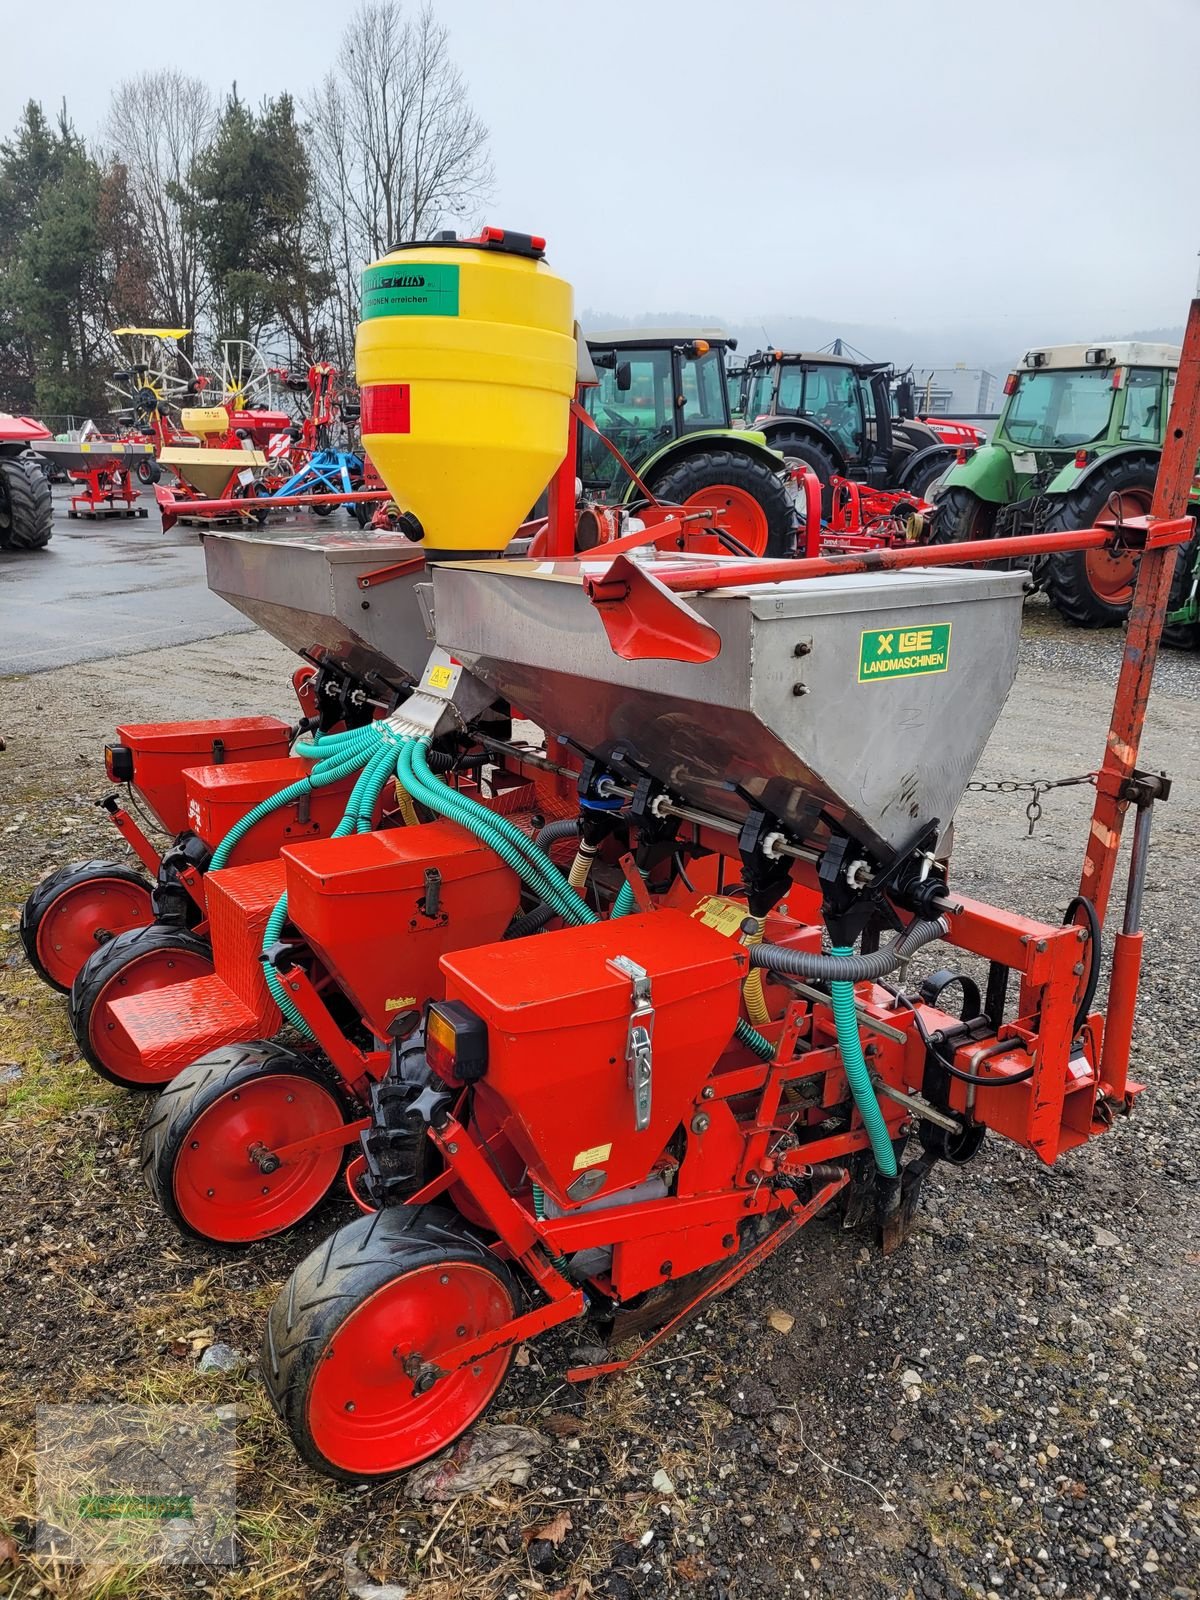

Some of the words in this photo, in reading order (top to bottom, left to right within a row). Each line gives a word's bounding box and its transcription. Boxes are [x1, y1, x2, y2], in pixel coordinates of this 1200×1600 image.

[390, 295, 428, 304] erreichen
[898, 630, 934, 653] LGE
[863, 653, 944, 674] LANDMASCHINEN
